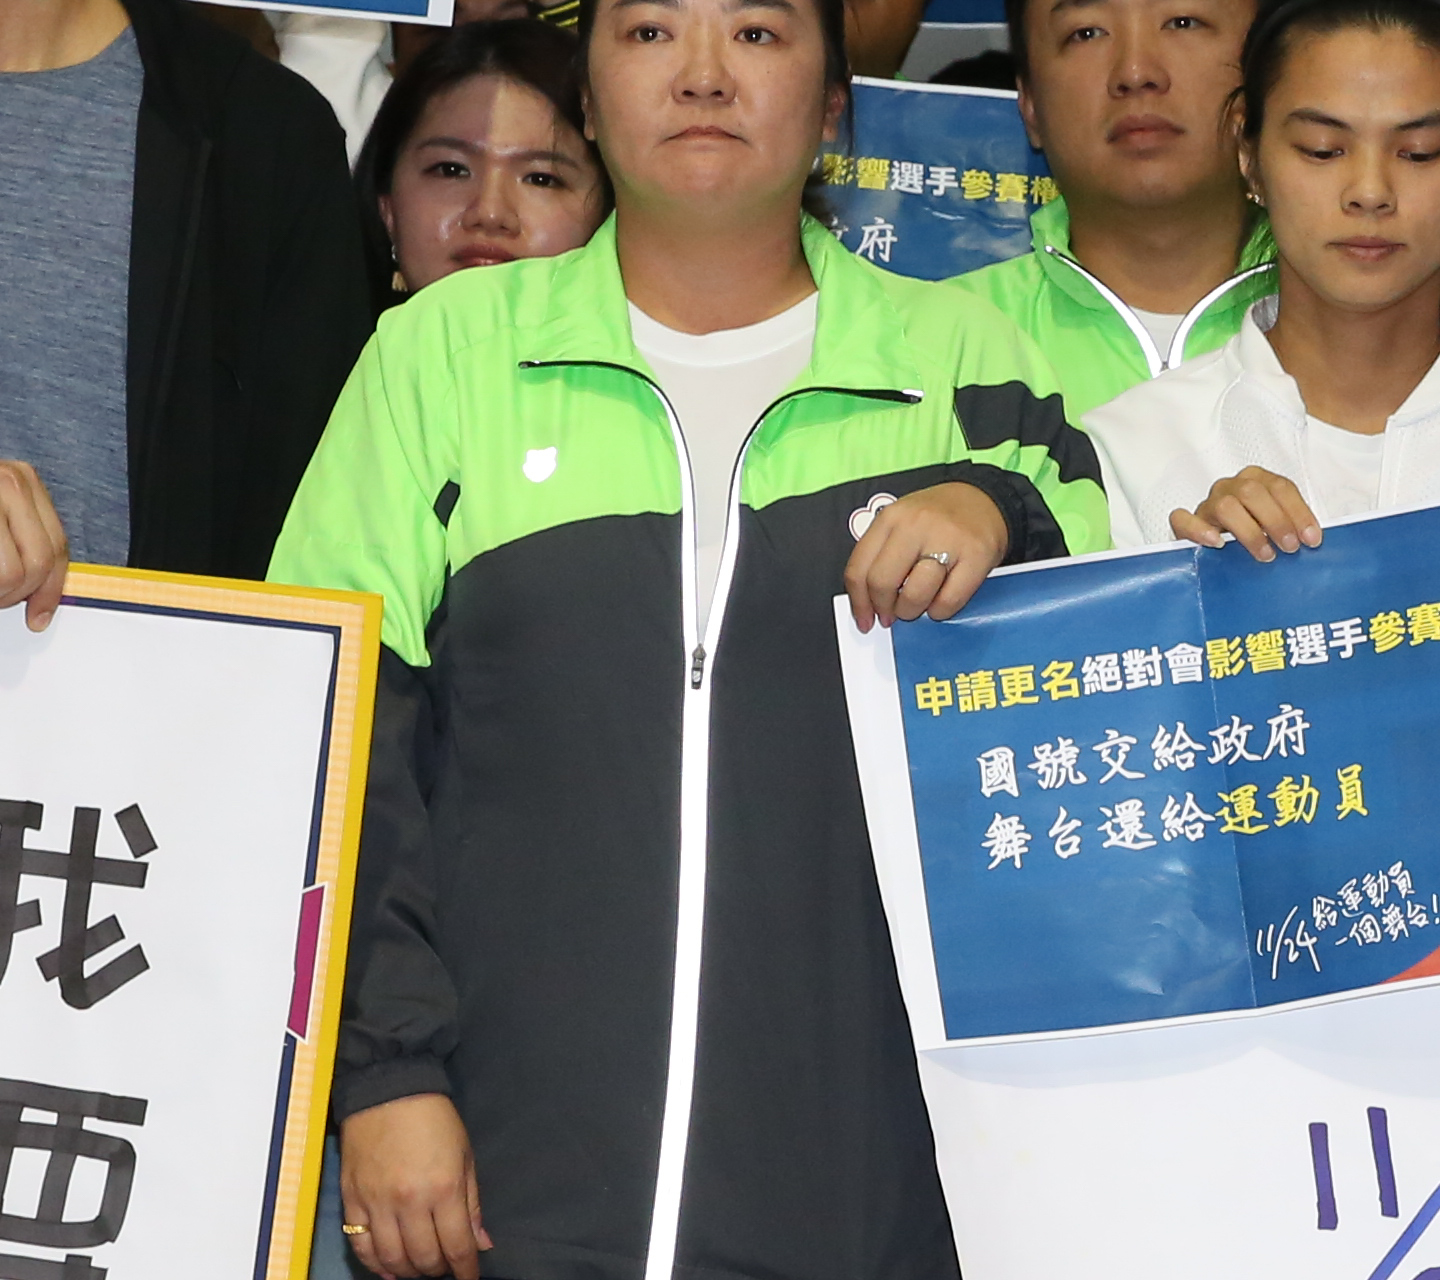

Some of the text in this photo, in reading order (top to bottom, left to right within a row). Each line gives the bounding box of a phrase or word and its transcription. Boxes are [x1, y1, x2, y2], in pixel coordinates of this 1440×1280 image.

[976, 703, 1310, 798] 國號交給政府
[980, 762, 1368, 871] 舞台還給運動員
[1312, 860, 1416, 930] 給運動員
[1256, 906, 1321, 979] 11/24
